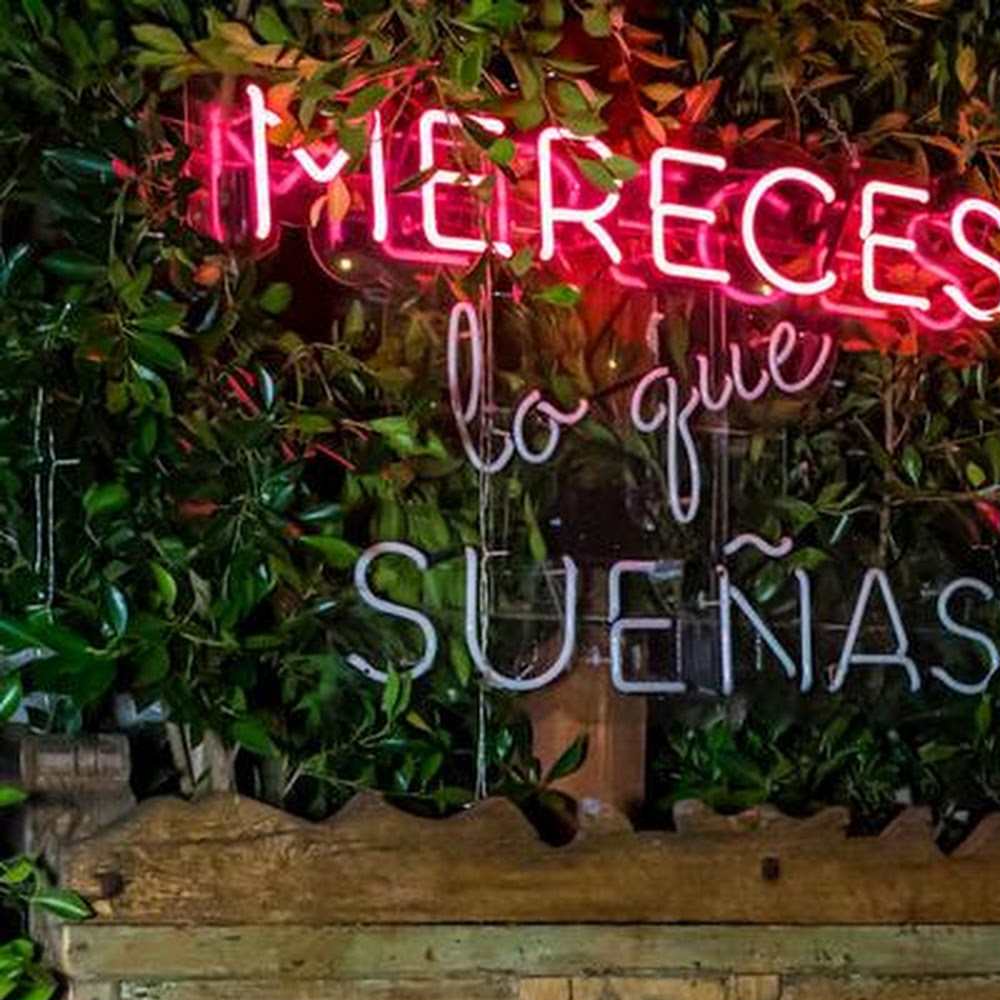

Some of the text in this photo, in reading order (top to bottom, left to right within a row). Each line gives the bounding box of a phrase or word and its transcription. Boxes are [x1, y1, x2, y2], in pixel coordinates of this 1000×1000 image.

[447, 301, 832, 524] lo que
[347, 533, 1000, 695] SUEÑAS
